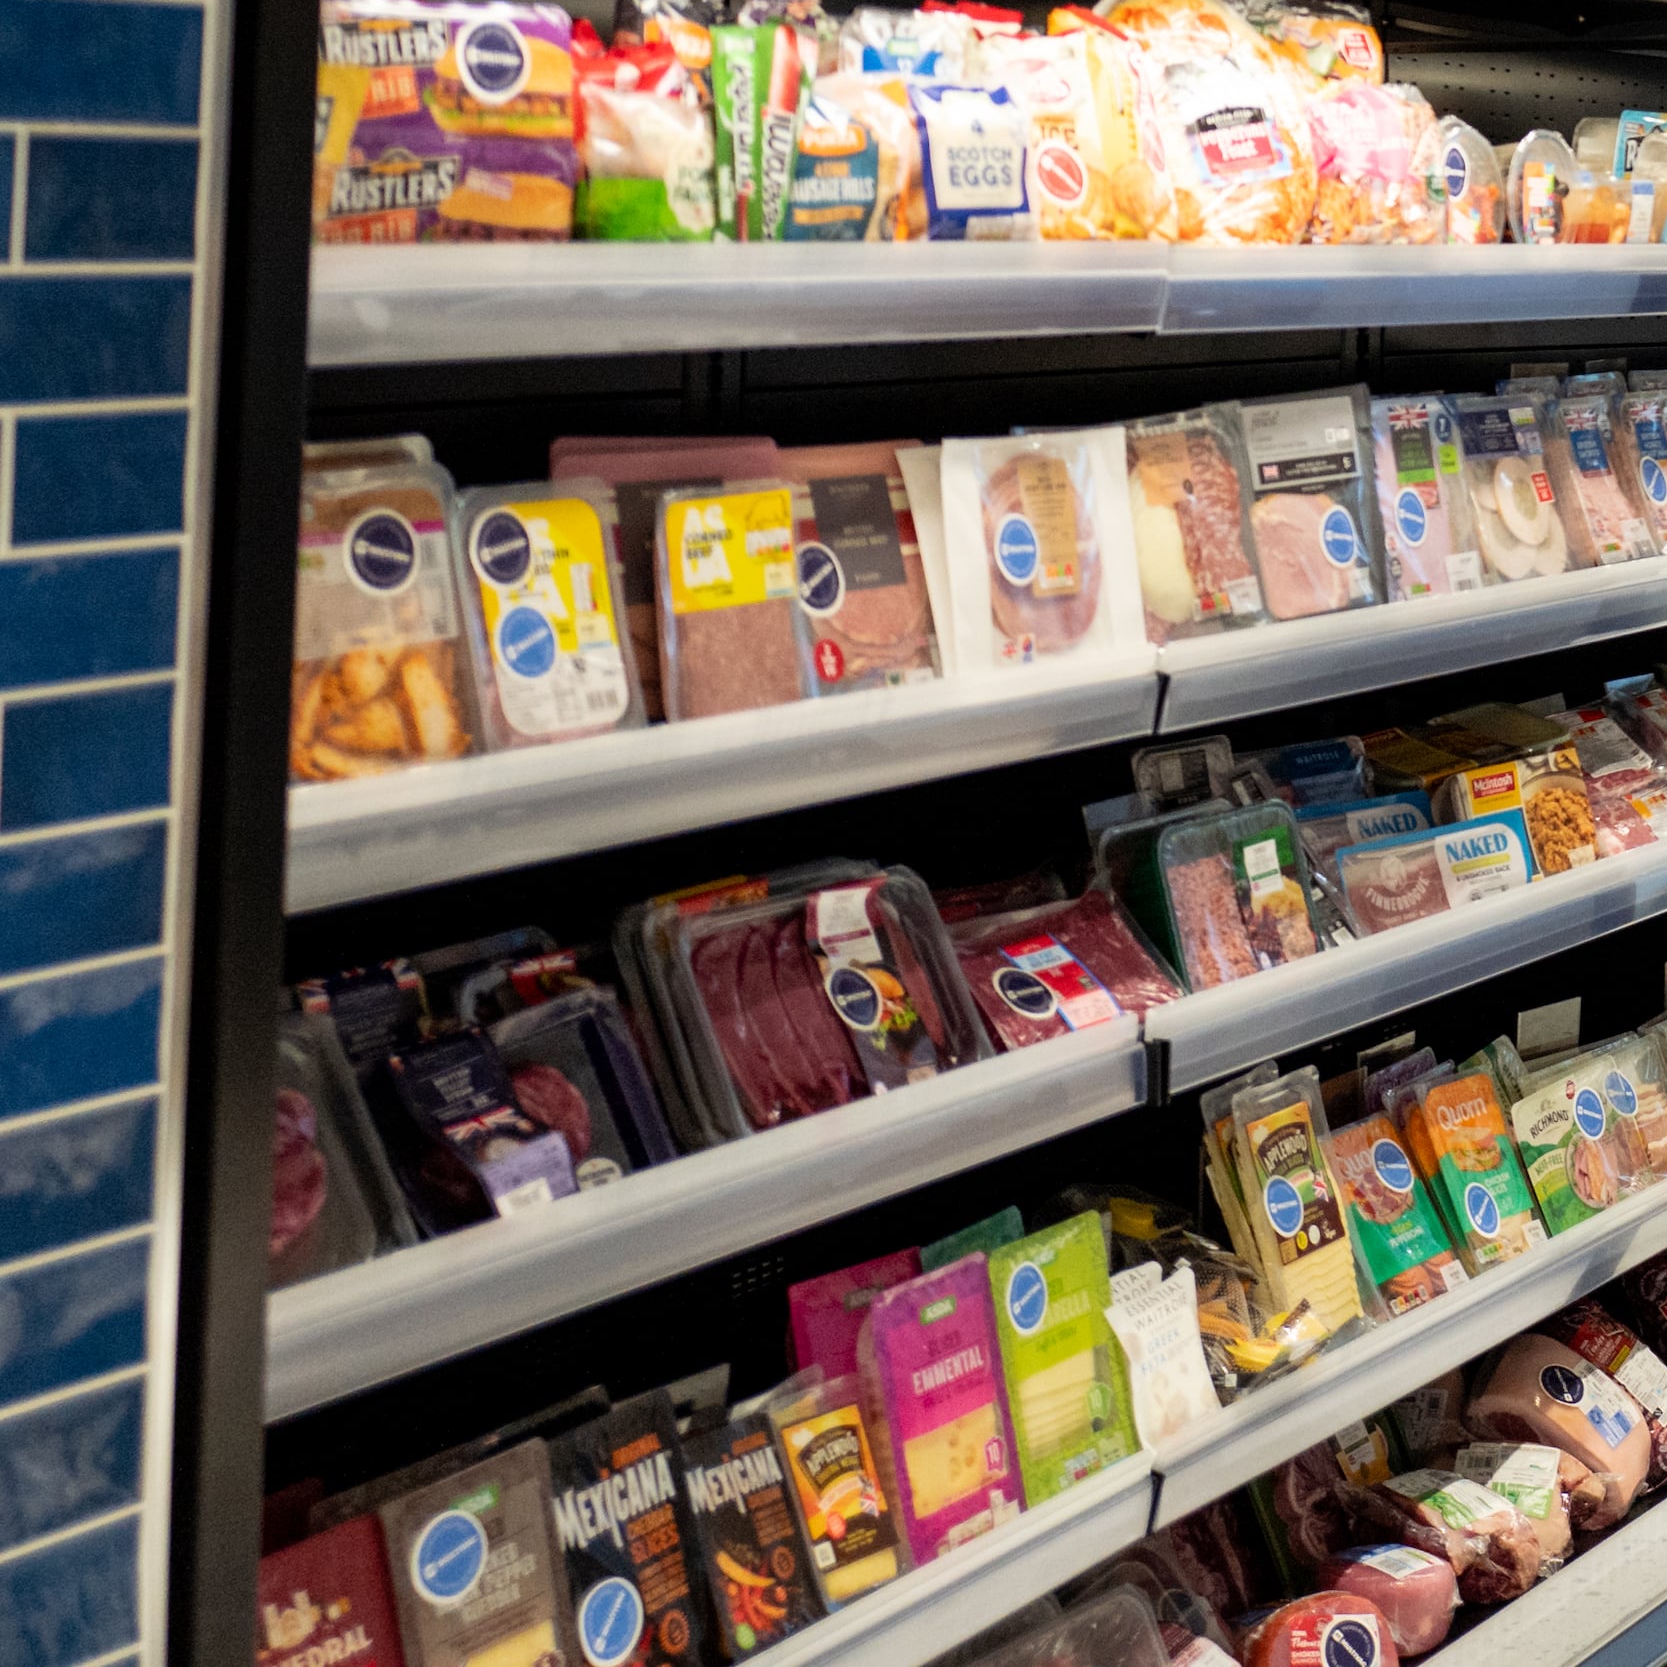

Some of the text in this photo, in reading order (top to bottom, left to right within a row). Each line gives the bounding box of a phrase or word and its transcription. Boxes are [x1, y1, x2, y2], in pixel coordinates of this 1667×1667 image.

[324, 18, 446, 66] RUSTLERS
[331, 159, 456, 212] RUSTLERS
[950, 166, 1012, 185] EGGS
[1357, 812, 1418, 837] NAKED
[1445, 832, 1508, 863] NAKED
[1437, 1097, 1488, 1132] Quorn
[1530, 1109, 1569, 1139] RICHMOND
[1264, 1134, 1307, 1172] APPLEWOOD
[1339, 1147, 1373, 1180] Quo
[1127, 1281, 1185, 1317] ESSENTIAL
[912, 1344, 985, 1396] EMMENTAL
[806, 1431, 859, 1477] APPLEWOOD
[685, 1445, 784, 1515] MEXICANA
[553, 1451, 677, 1552] MEXICANA
